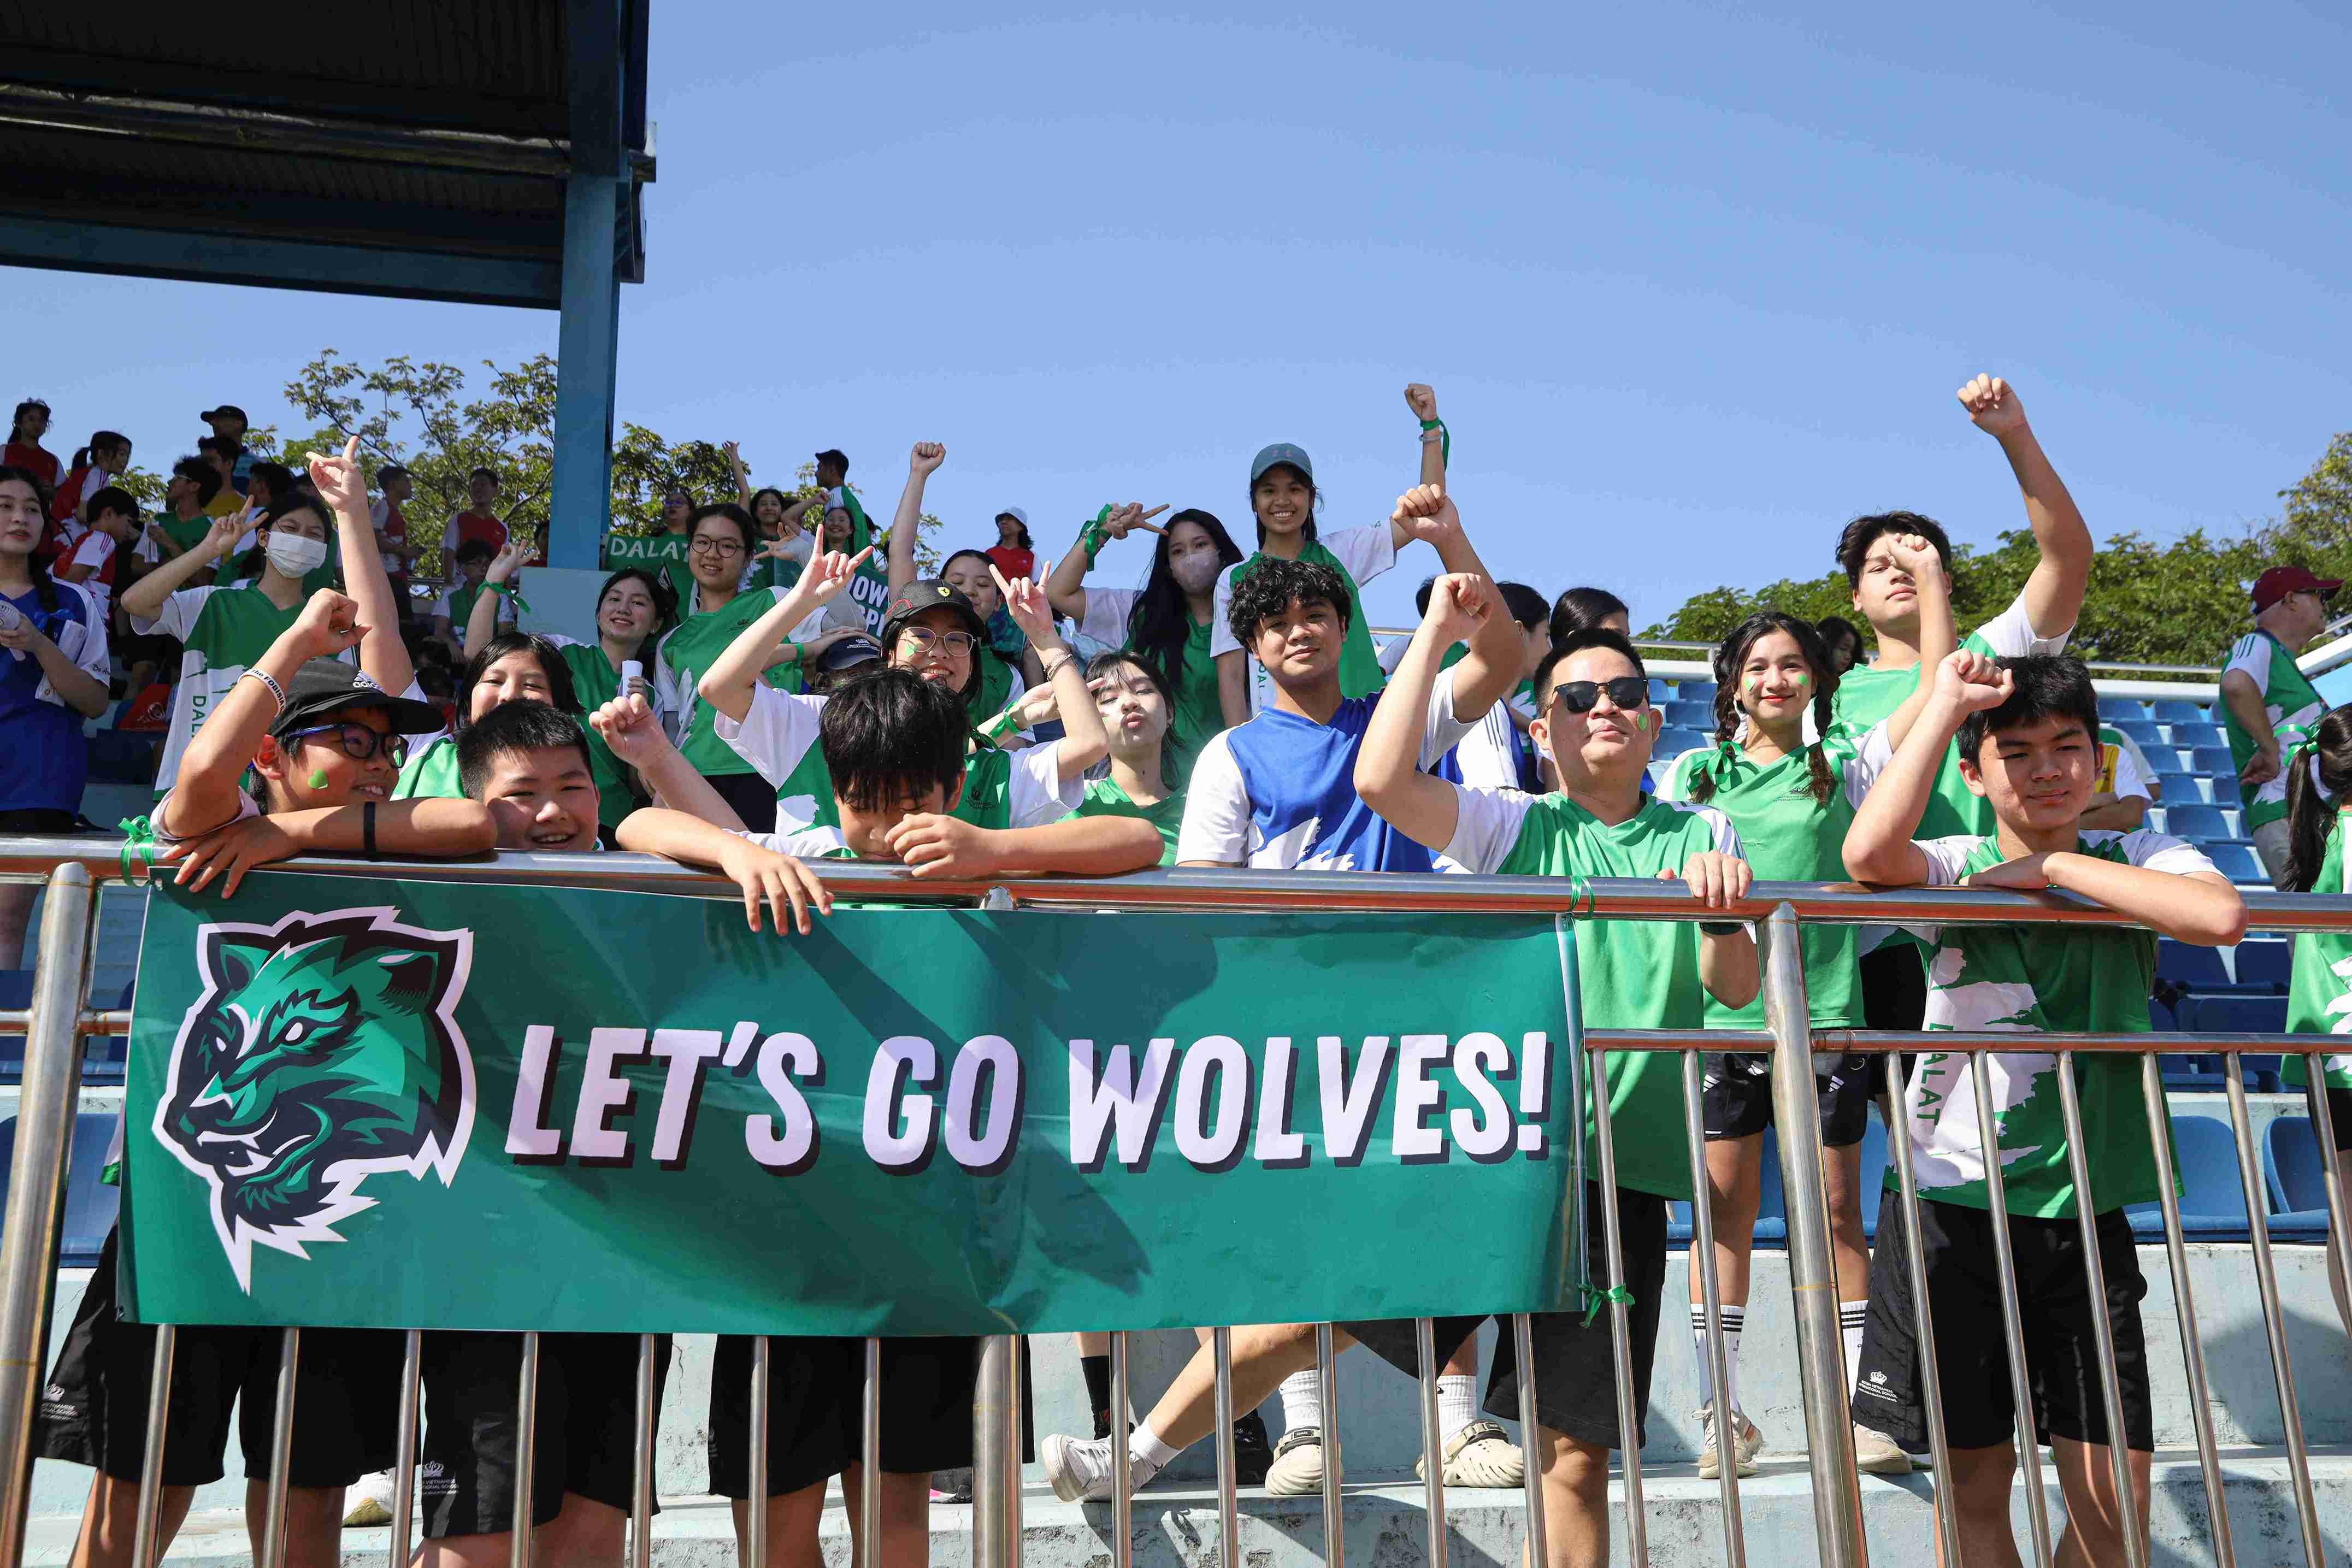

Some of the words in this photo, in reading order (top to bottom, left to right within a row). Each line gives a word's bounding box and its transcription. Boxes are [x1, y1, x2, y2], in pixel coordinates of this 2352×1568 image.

[192, 695, 207, 738] DAL
[505, 1021, 824, 1176] LET'S
[862, 1034, 1025, 1176] GO
[1069, 1031, 1553, 1174] WOLVES!
